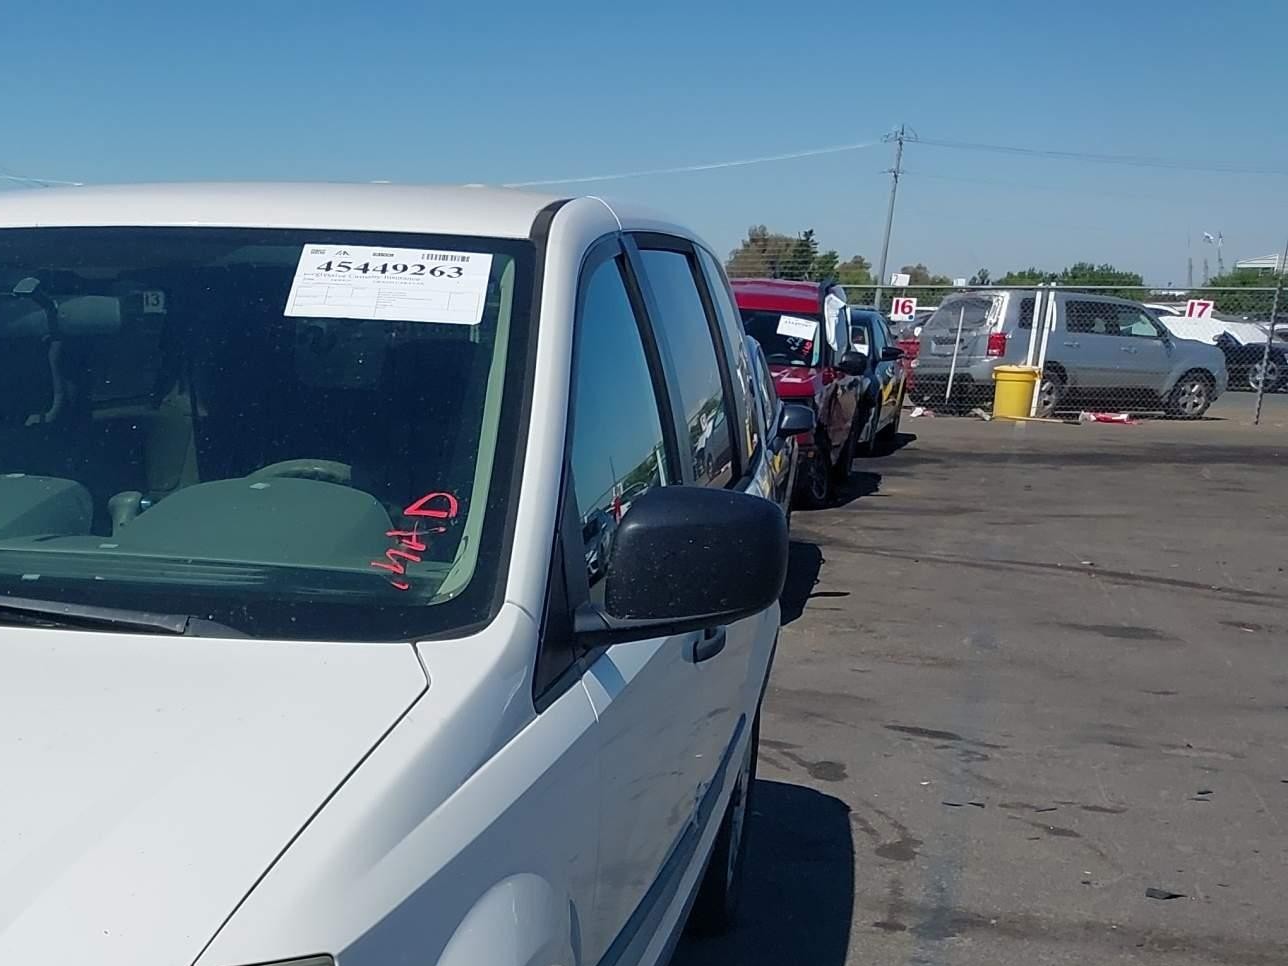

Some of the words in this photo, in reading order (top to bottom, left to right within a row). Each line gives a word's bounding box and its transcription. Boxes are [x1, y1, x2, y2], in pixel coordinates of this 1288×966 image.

[316, 260, 464, 279] 45449263
[144, 292, 161, 308] 13
[893, 299, 914, 315] 16
[1187, 301, 1211, 318] 17
